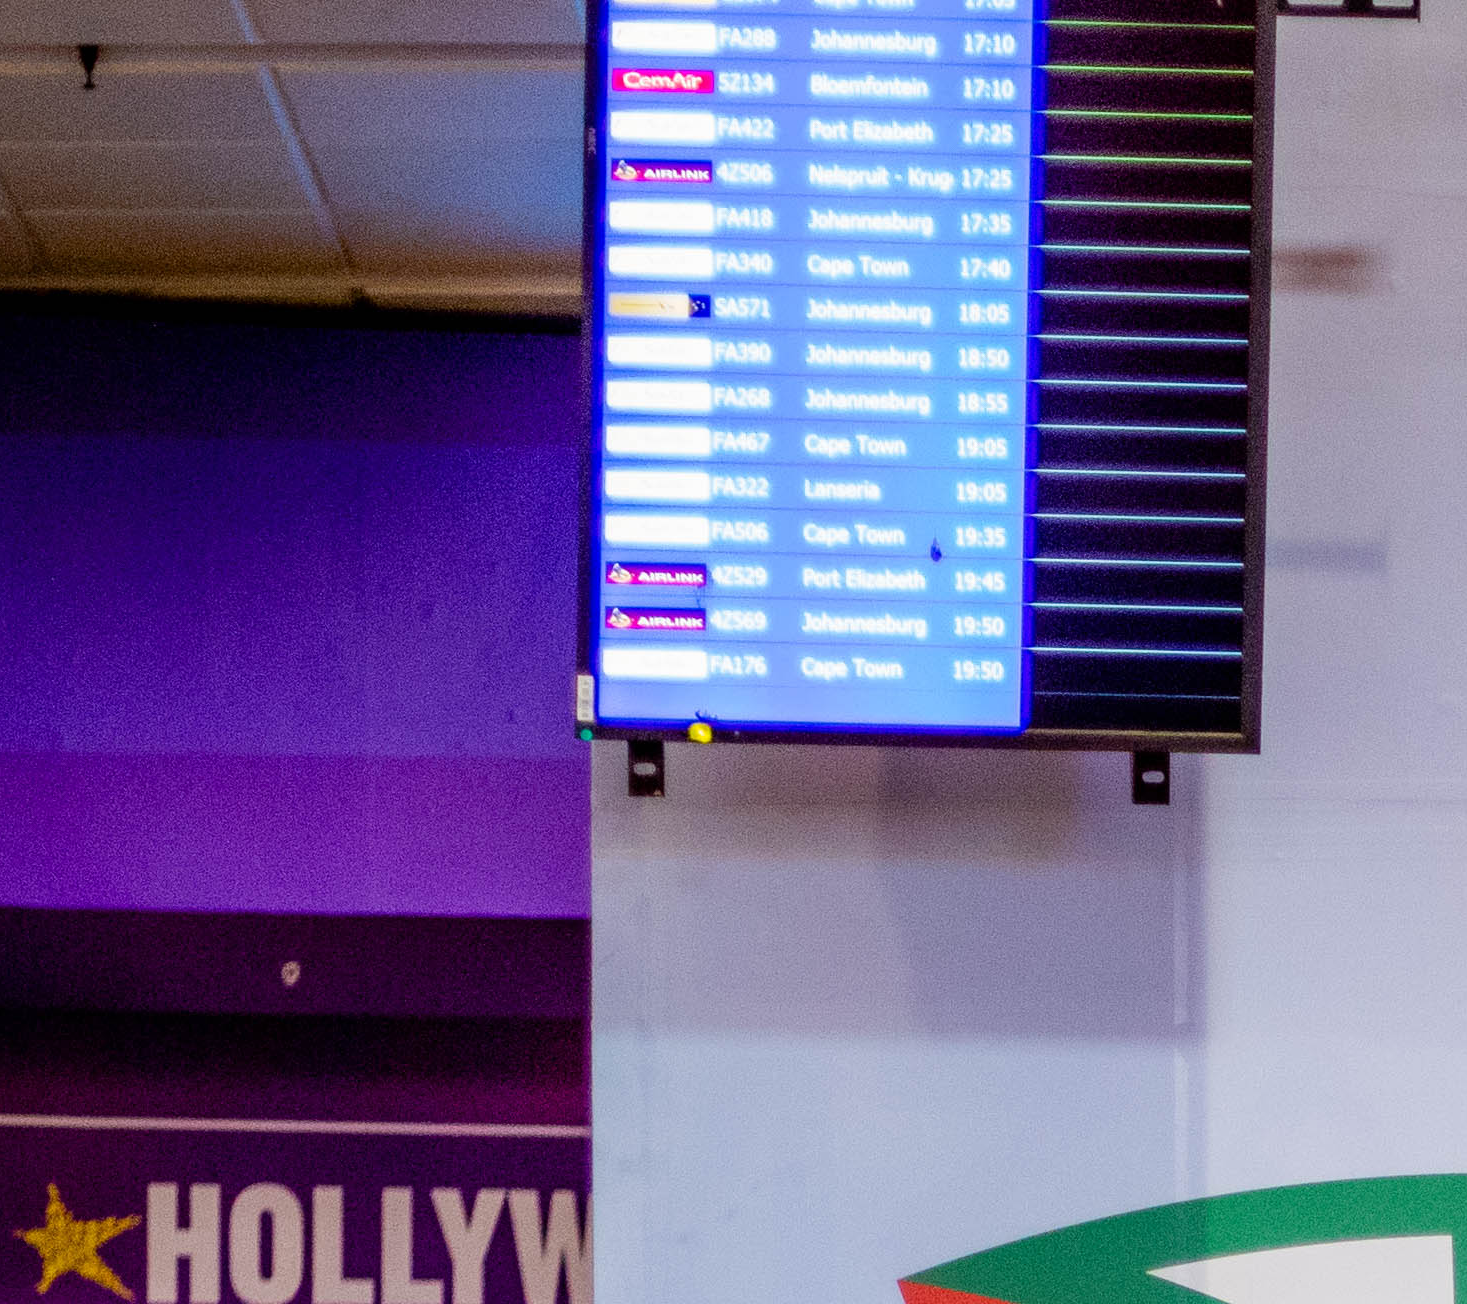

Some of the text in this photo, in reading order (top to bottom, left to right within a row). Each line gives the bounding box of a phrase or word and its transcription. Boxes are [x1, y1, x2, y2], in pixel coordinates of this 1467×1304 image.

[811, 29, 937, 57] Johannesburg
[965, 33, 1015, 54] 17:10
[622, 71, 704, 90] CemAir
[810, 74, 929, 97] Bloemfontein
[964, 78, 1014, 99] 17:10
[716, 117, 1013, 144] FA422 Port Elizabeth 17:25
[643, 168, 710, 181] AIRLINK
[716, 162, 774, 184] 4Z506
[809, 164, 889, 189] Nelspruit
[962, 168, 1012, 189] 17:25
[715, 207, 1011, 237] FA418 Johannesburg 17:35
[714, 252, 1011, 279] FA340 Cape Town 17:40
[715, 297, 1010, 326] SA571 Johannesburg 18:05
[713, 342, 1010, 371] FA390 Johannesburg 18:50
[805, 389, 931, 416] Johannesburg
[958, 392, 1008, 413] 18:55
[711, 431, 1007, 458] FA467 Cape Town 19:05
[711, 476, 1007, 502] FA322 Lanseria 19:05
[710, 521, 1006, 547] FA506 Cape Town 19:35
[637, 565, 1005, 592] AIRLINK 4Z529 Port Elizabeth 19:45
[636, 609, 1005, 639] AIRLINK 4Z569 Johannesburg 19:50
[708, 654, 1004, 681] FA176 Cape Town 19:50
